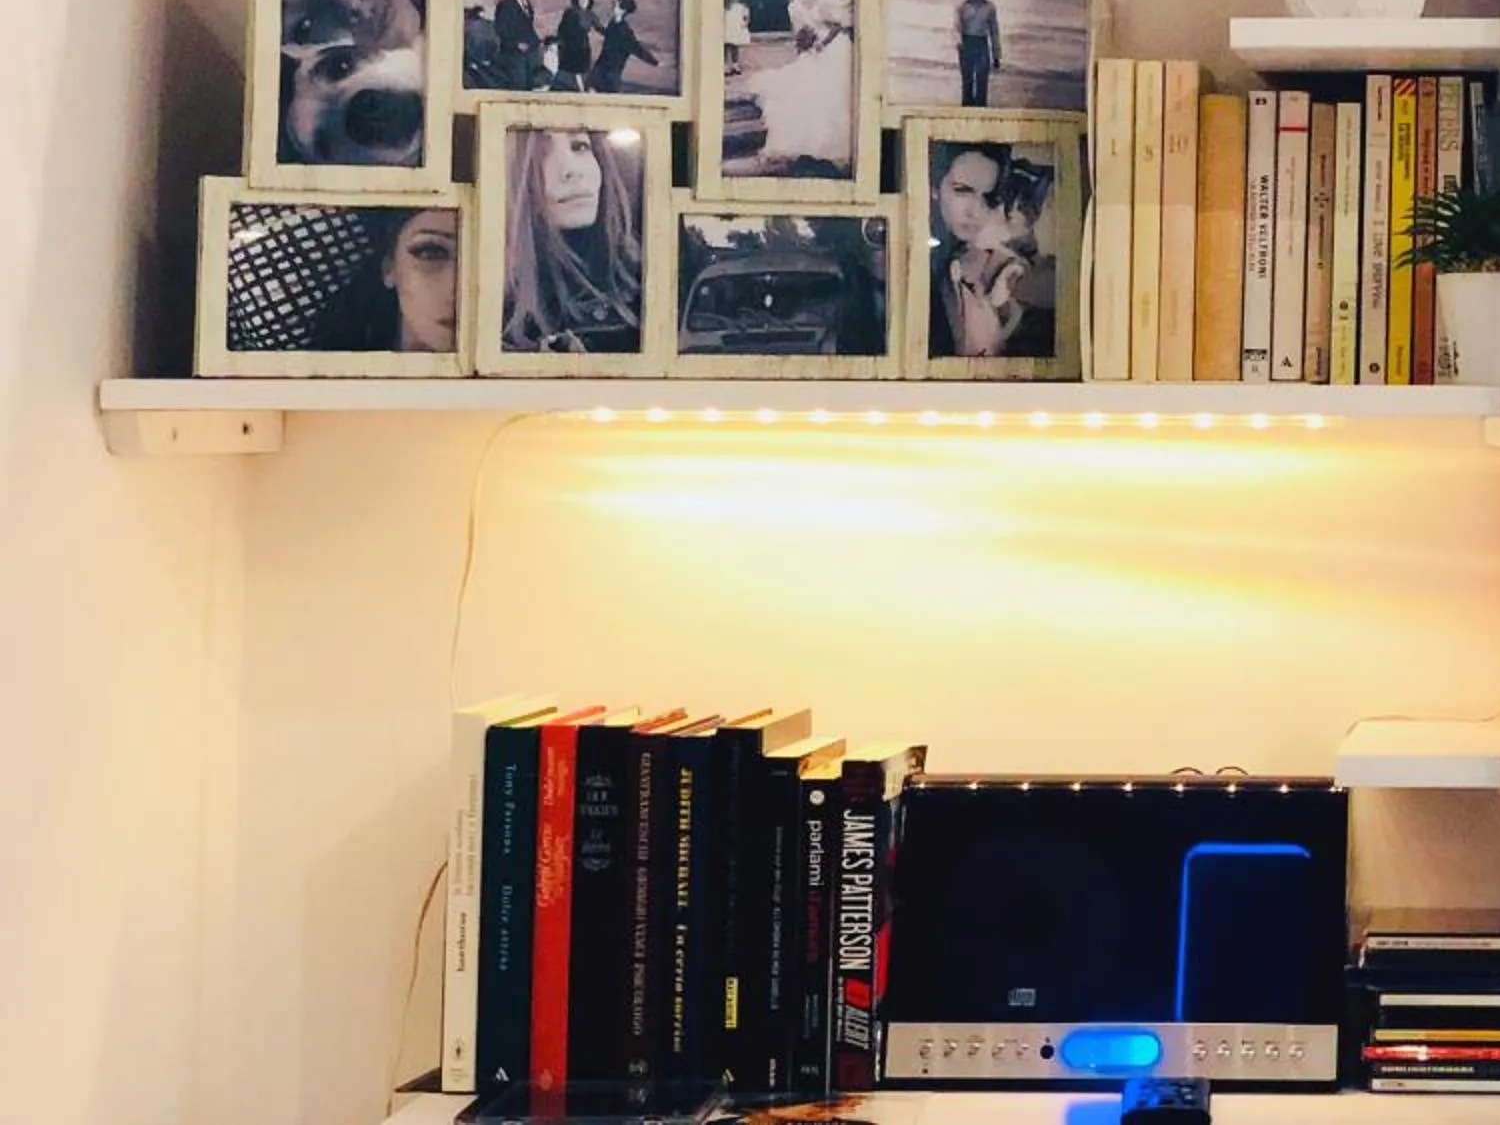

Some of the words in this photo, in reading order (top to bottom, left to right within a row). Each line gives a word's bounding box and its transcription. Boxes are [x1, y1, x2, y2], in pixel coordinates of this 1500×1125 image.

[1259, 174, 1269, 219] WALTER
[1257, 223, 1268, 279] VELTRONI
[503, 763, 517, 796] Tony
[677, 765, 693, 832] JUDITH
[807, 820, 825, 887] parlami
[840, 809, 876, 870] JAMES
[677, 834, 690, 909] MICHAEL
[838, 873, 873, 971] PATTERSON
[844, 1004, 871, 1050] ALERT
